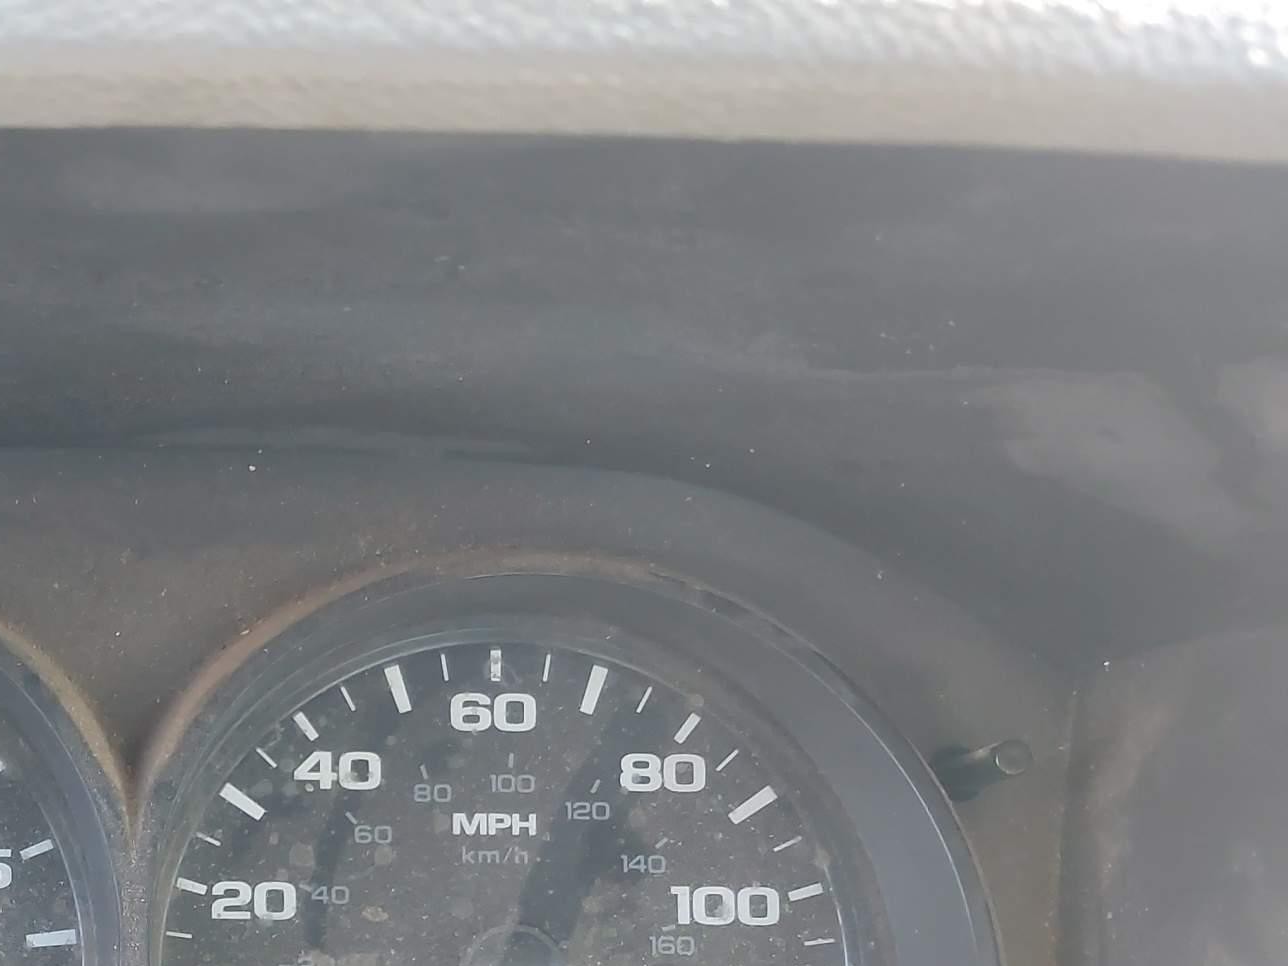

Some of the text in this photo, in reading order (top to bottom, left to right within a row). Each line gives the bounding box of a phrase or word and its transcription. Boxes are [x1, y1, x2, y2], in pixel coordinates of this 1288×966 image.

[449, 692, 537, 733] 60
[293, 751, 381, 791] 40
[620, 753, 706, 793] 80
[413, 784, 452, 803] 80
[489, 774, 536, 793] 100
[565, 801, 611, 821] 120
[452, 813, 537, 836] MPH
[353, 825, 393, 845] 60
[462, 846, 529, 865] km/h
[620, 855, 666, 874] 140
[212, 881, 297, 920] 20
[312, 886, 350, 905] 40
[670, 886, 780, 926] 100
[649, 936, 695, 956] 160
